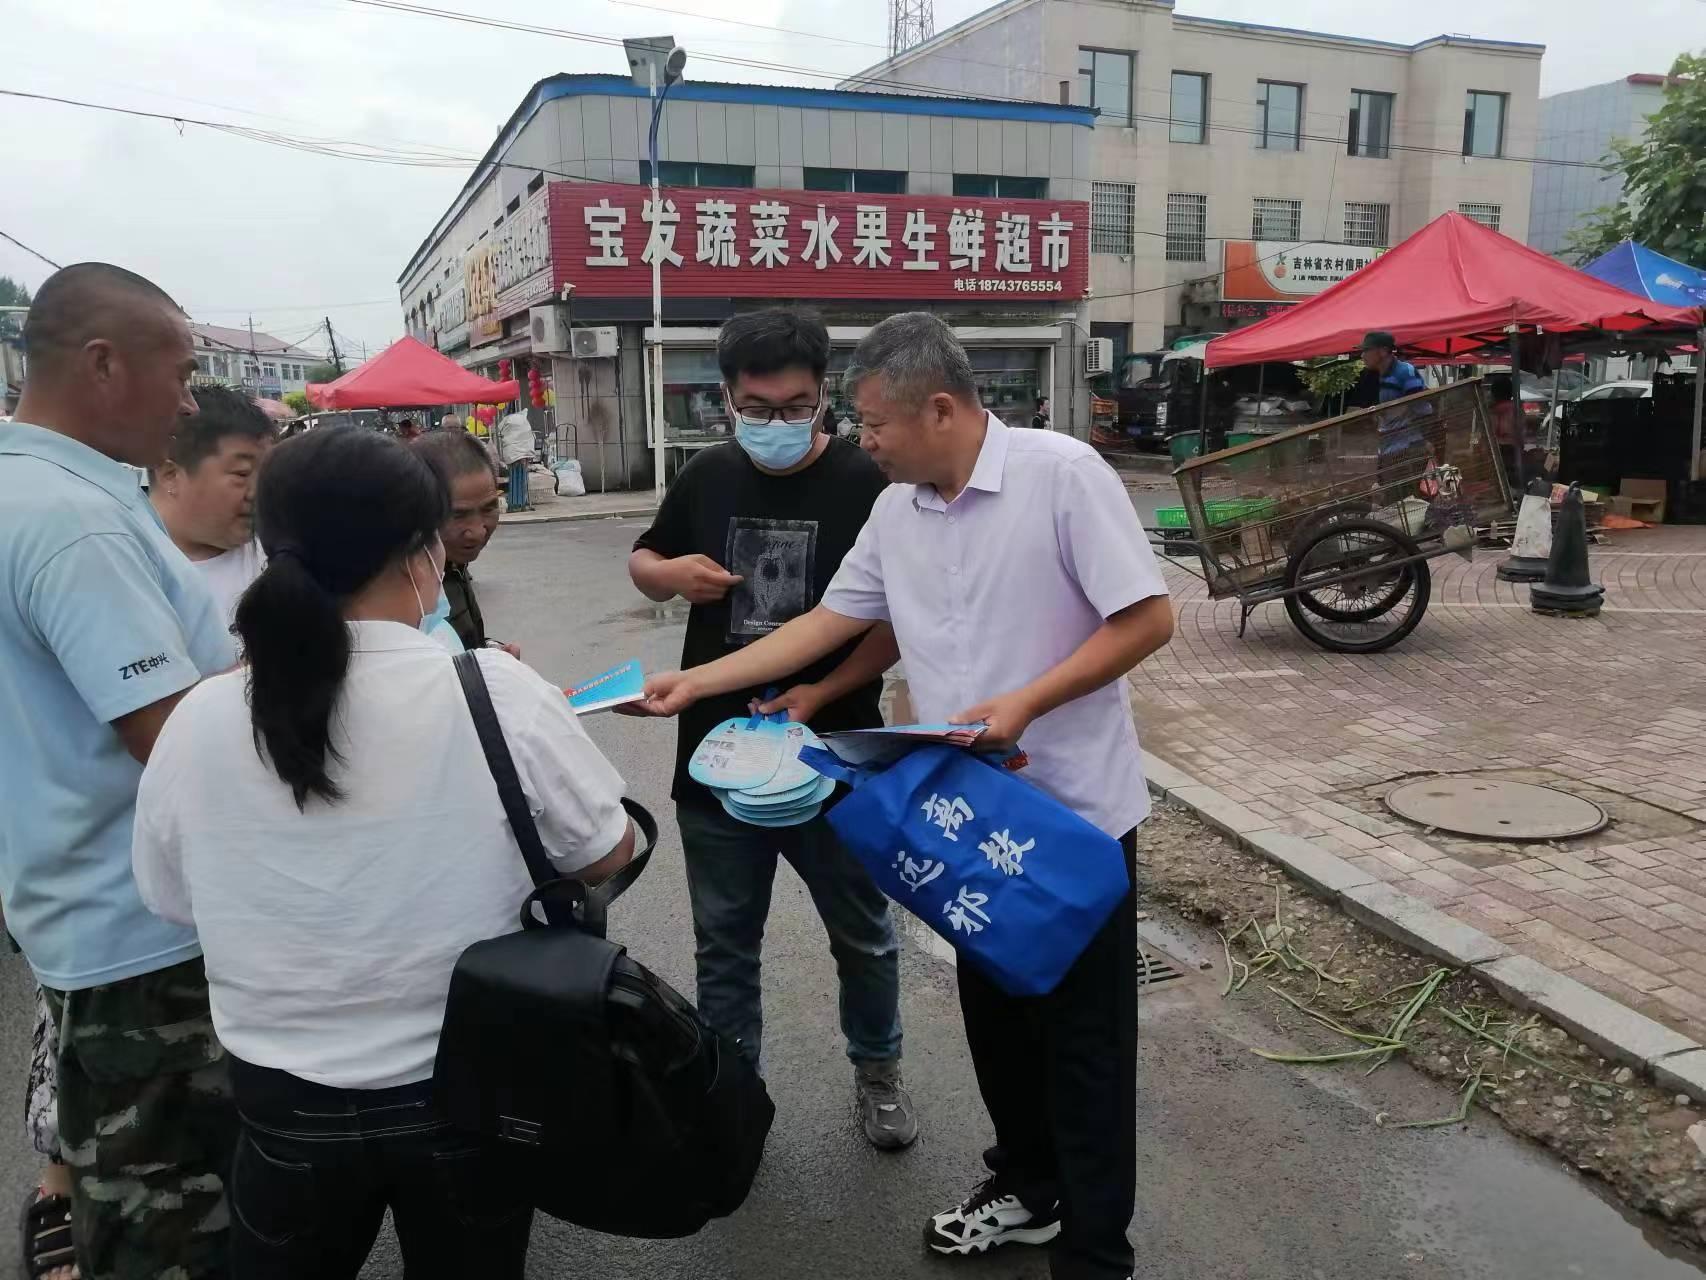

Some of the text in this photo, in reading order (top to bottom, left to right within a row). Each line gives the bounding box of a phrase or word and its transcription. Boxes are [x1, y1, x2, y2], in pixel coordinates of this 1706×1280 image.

[584, 198, 1074, 272] 宝发蔬菜水果生鲜超市
